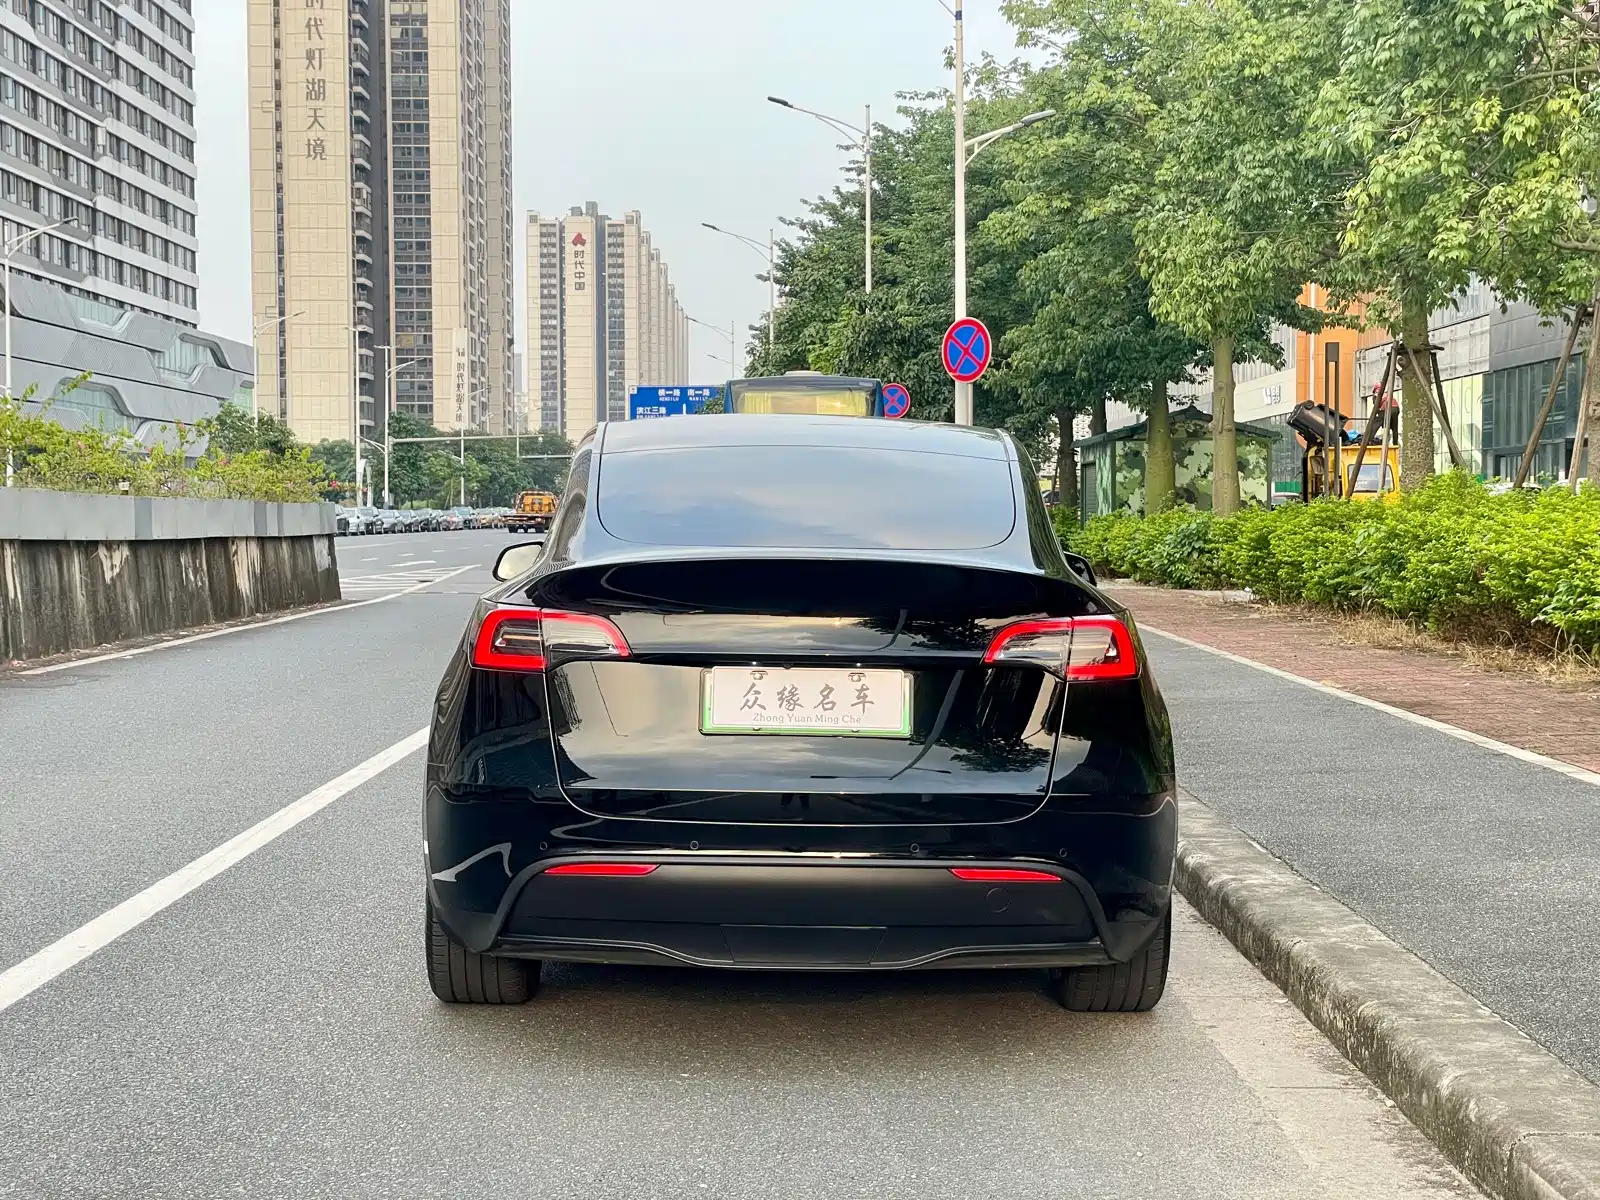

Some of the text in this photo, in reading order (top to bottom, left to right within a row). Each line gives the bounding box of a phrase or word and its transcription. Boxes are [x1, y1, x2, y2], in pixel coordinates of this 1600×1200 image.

[573, 250, 586, 291] 时代中国
[740, 682, 875, 715] 众缘名车
[752, 712, 862, 725] Zhong Yuan Ming Che
